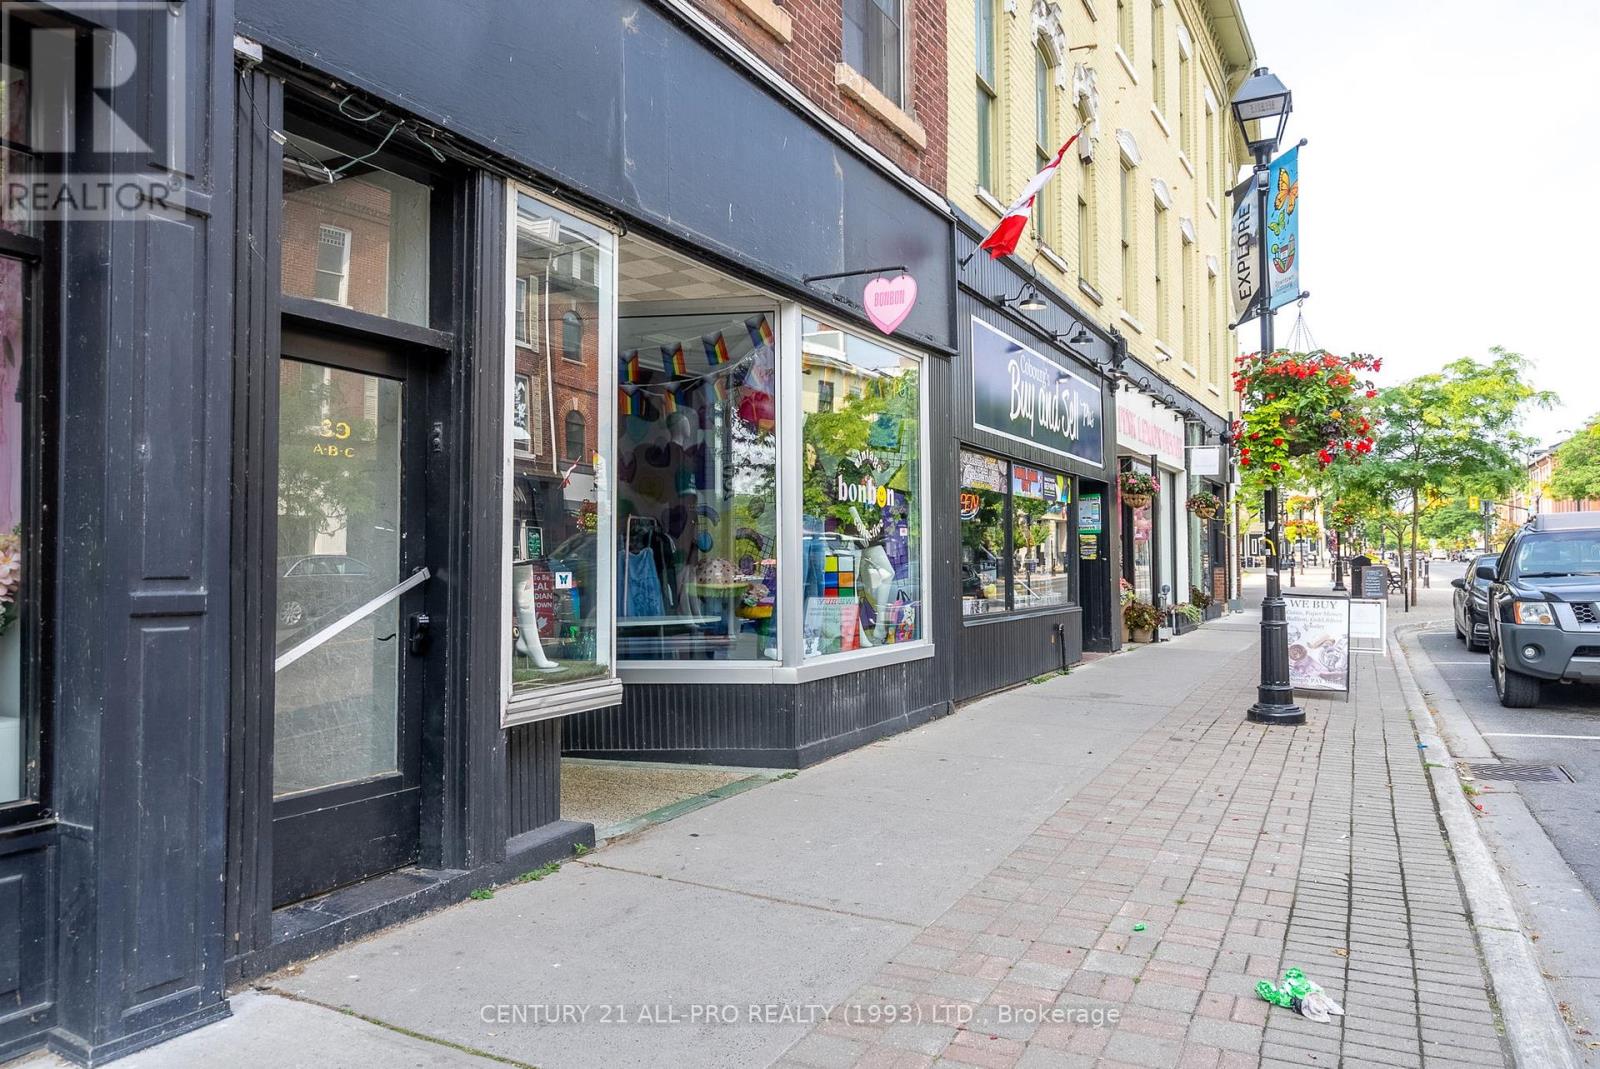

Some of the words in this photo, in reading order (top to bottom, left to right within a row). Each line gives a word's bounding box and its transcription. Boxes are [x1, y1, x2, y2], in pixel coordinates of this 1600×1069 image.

[1237, 203, 1251, 300] EXPLORE
[1007, 359, 1035, 437] Buy
[1038, 380, 1060, 432] and
[1061, 389, 1079, 440] Sell
[1290, 599, 1309, 609] WE
[1312, 600, 1338, 610] BUY
